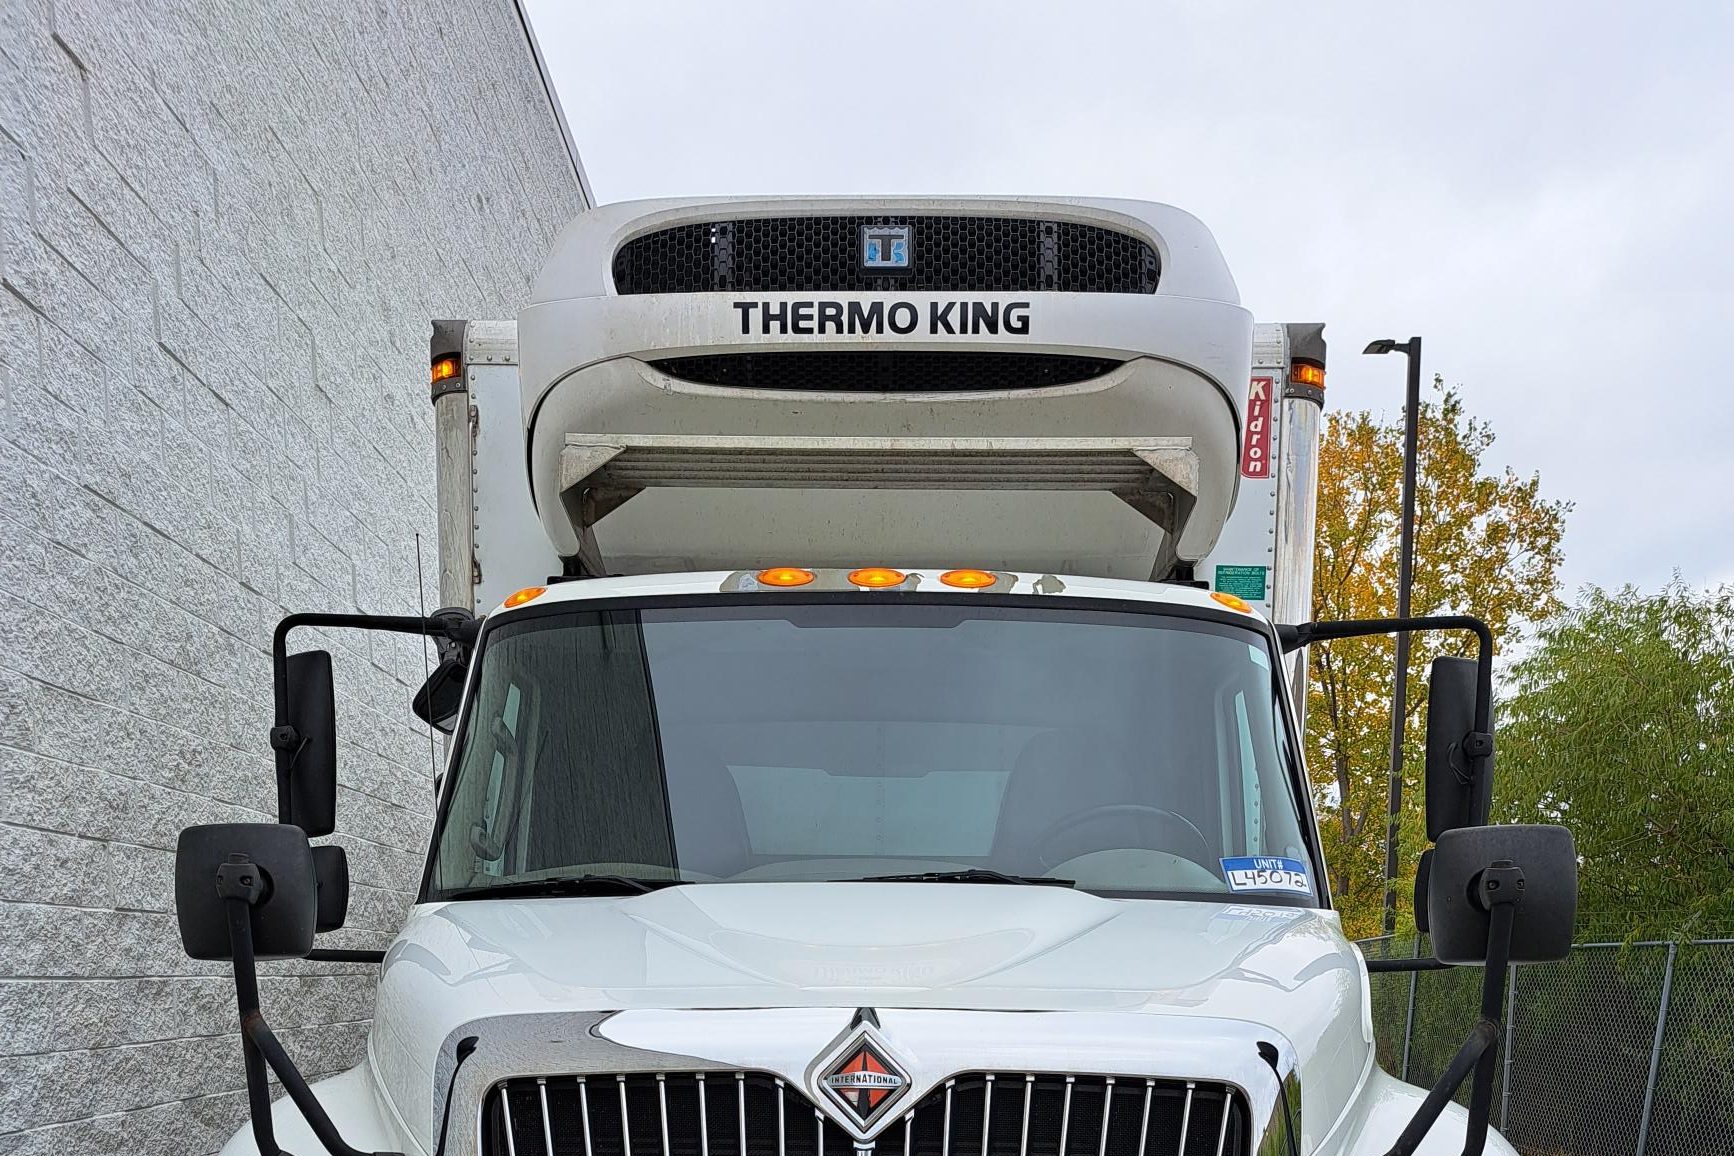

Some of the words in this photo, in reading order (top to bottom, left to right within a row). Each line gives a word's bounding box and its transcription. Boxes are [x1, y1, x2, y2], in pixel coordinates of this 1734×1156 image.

[733, 301, 919, 335] THERMO
[929, 301, 1030, 335] KING
[1248, 381, 1267, 472] Kidron
[1253, 859, 1283, 869] UNIT#
[1231, 870, 1306, 887] L45072
[831, 1074, 898, 1084] INTERNATIONAL
